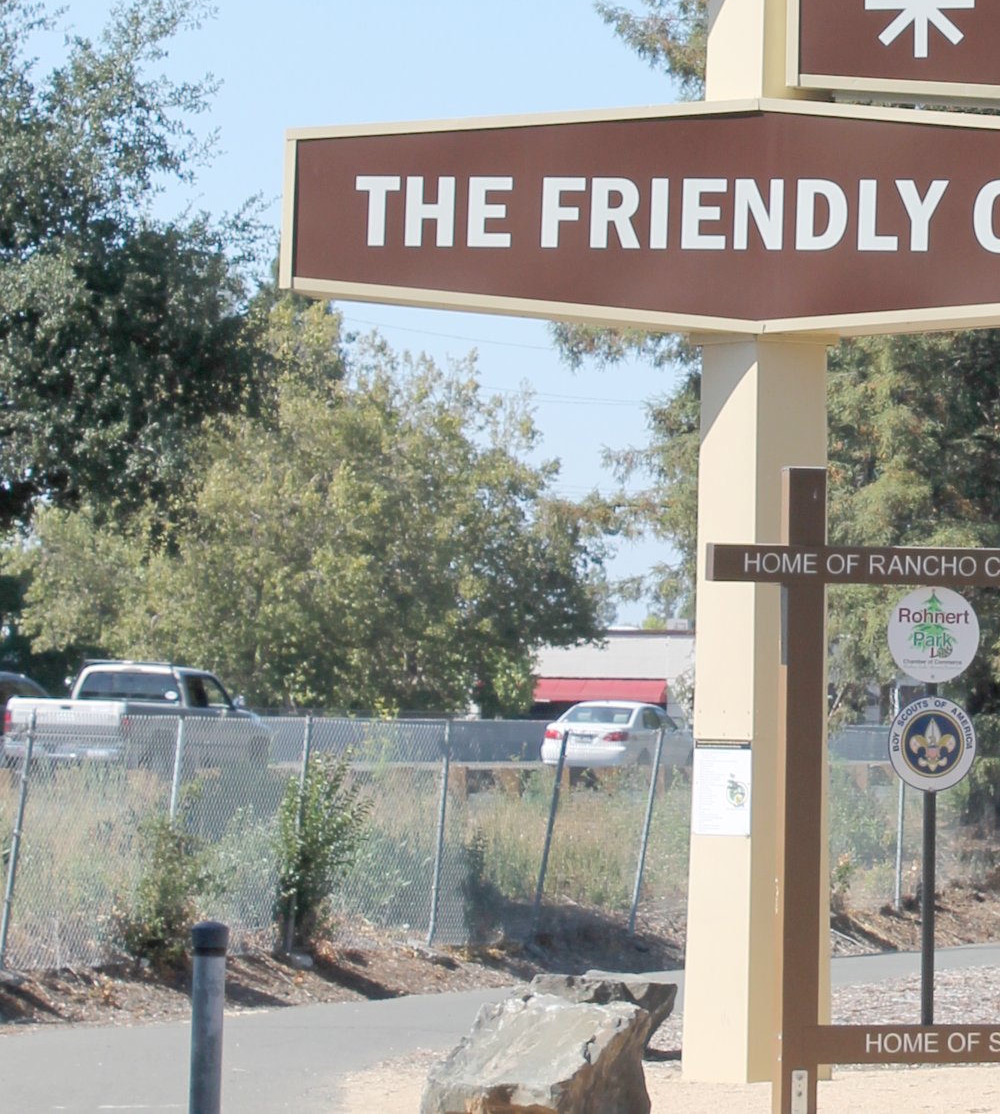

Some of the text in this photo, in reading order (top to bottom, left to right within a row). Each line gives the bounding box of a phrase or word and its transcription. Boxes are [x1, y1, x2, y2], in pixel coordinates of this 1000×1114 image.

[355, 175, 513, 248] THE
[540, 176, 949, 252] FRIENDLY
[744, 552, 817, 574] HOME
[826, 553, 859, 575] OF
[870, 555, 977, 577] RANCHO
[898, 608, 970, 624] Rohnert
[913, 632, 952, 647] Park
[892, 700, 973, 752] BOY SCOUTS OF AMERICA
[865, 1032, 939, 1053] HOME
[947, 1032, 980, 1053] OF
